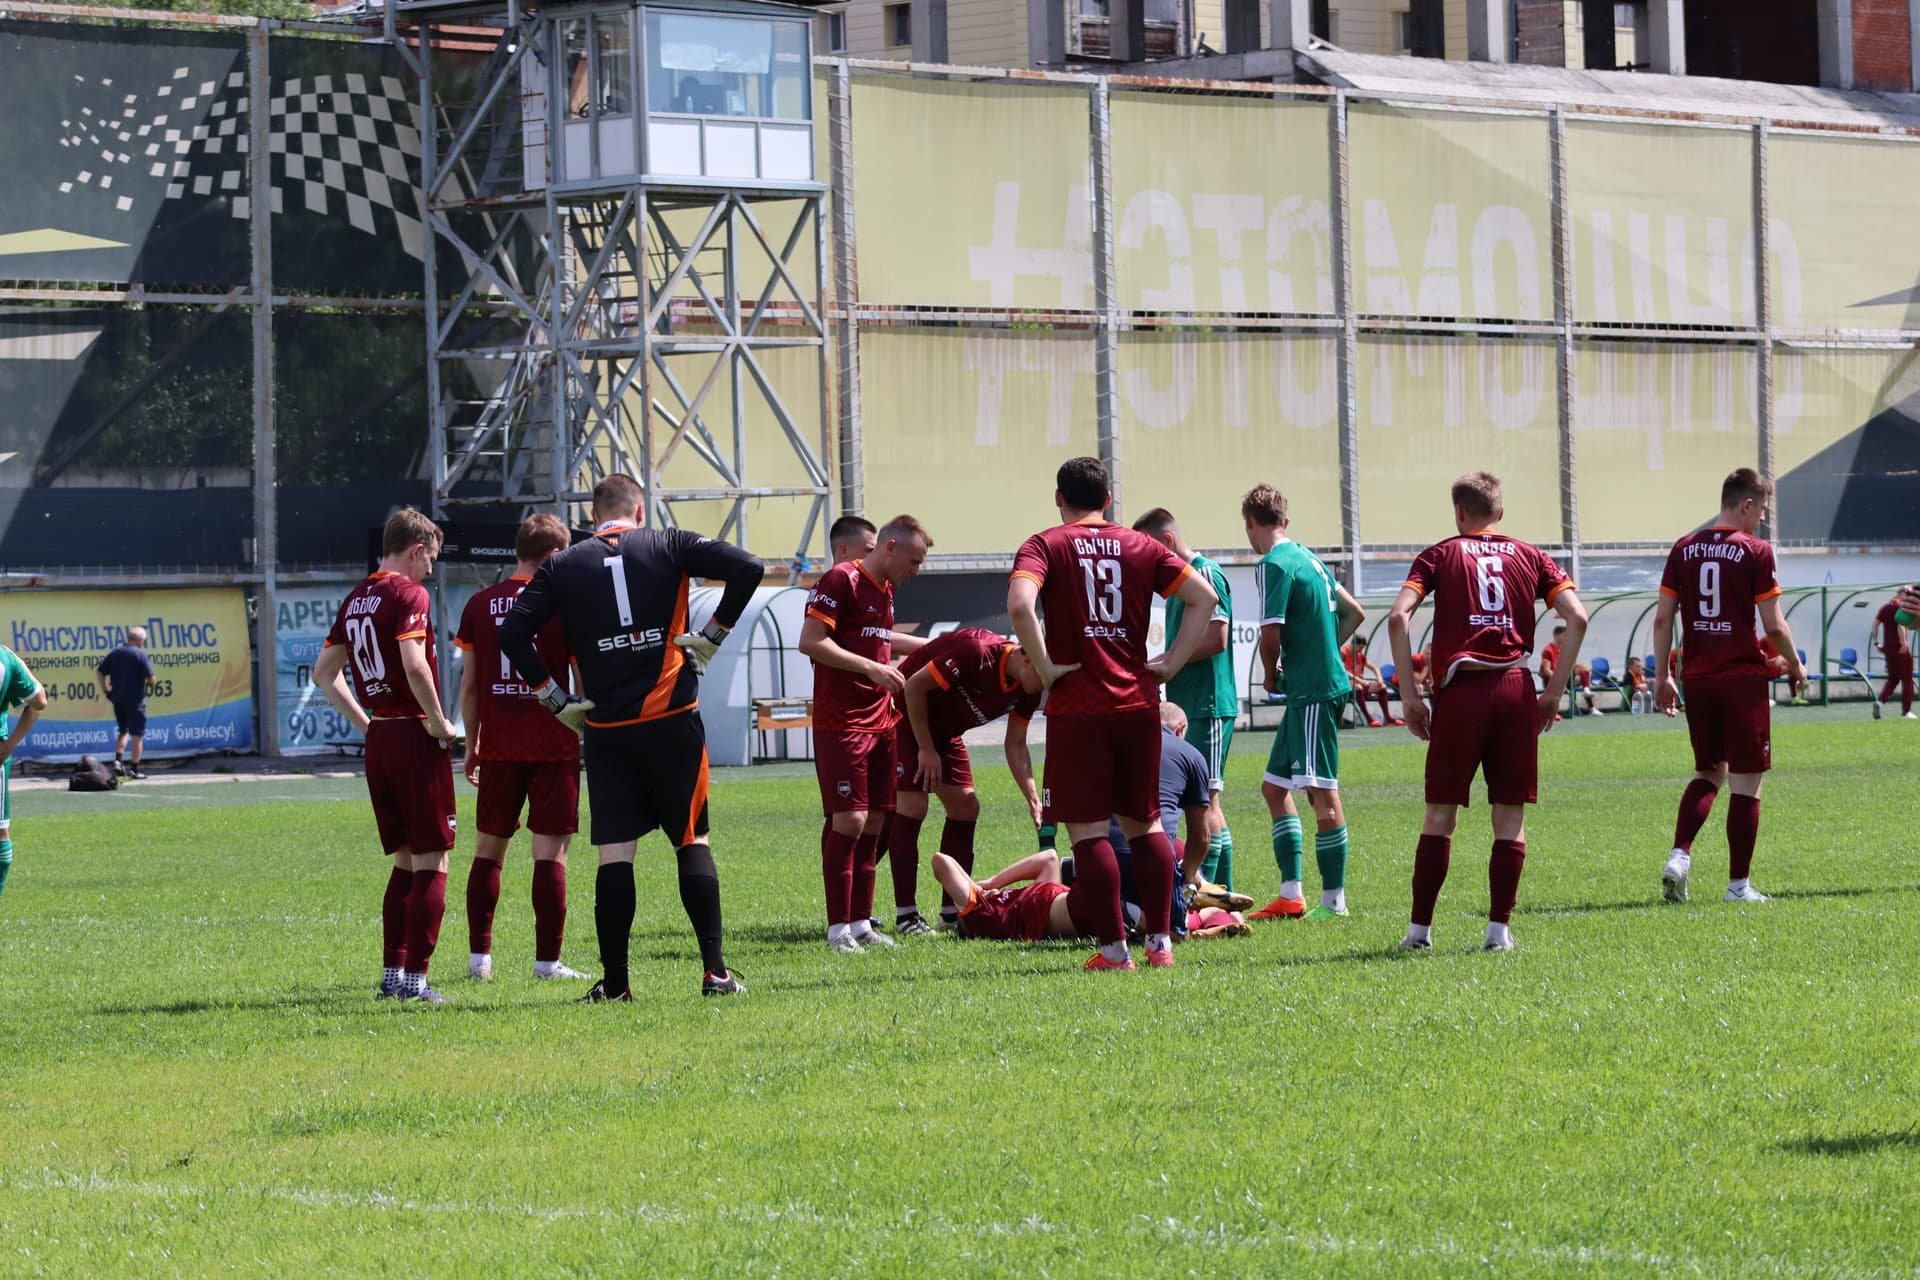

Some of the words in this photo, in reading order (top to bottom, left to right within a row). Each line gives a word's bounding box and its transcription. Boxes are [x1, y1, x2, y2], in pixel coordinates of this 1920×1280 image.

[961, 180, 1802, 471] #ЭТОМОЩНО
[1074, 537, 1121, 556] СЫЧЕВ
[1682, 542, 1745, 563] ГРЕЧНИКОВ
[603, 554, 634, 627] 1
[1078, 558, 1123, 623] 13
[1477, 556, 1505, 612] 6
[1699, 561, 1721, 618] 9
[1084, 626, 1128, 640] SEUS
[1469, 615, 1513, 629] SEUS
[1693, 621, 1732, 631] SEUS
[346, 616, 386, 682] 20
[597, 628, 662, 652] SEUS
[21, 655, 80, 672] адежная
[151, 650, 220, 667] поддержка
[32, 730, 108, 748] поддержка
[175, 721, 235, 742] бизнесу!
[288, 711, 317, 742] 90
